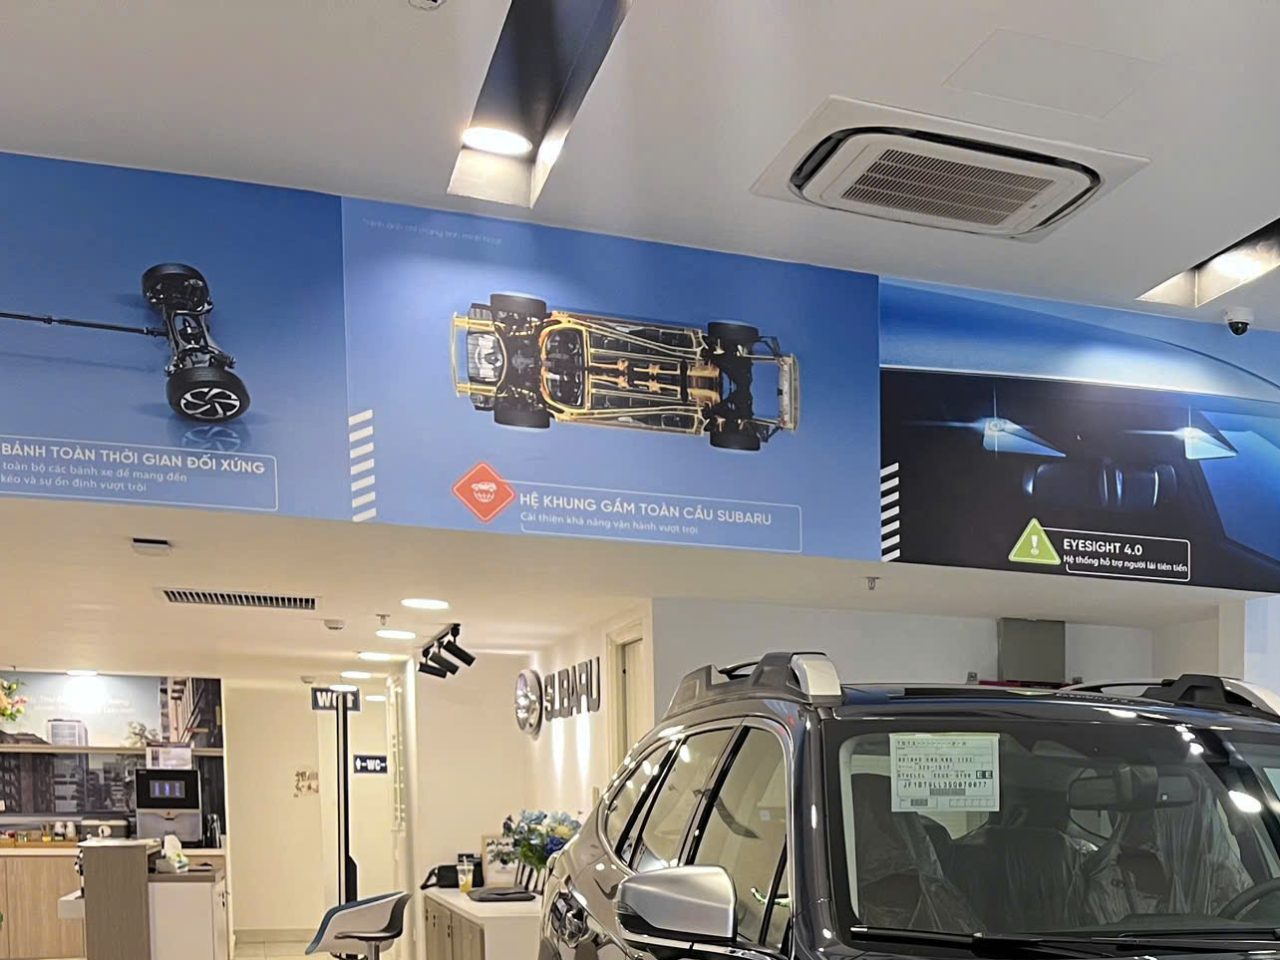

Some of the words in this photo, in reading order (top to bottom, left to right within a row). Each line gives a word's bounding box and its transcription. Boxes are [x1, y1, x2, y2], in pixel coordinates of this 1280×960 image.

[50, 445, 96, 461] TOÀN
[142, 453, 182, 467] GIAN
[187, 453, 216, 470] ĐỐI
[220, 457, 265, 474] XỨNG
[2, 461, 28, 471] toàn
[31, 461, 46, 473] bộ
[48, 464, 66, 475] các
[69, 464, 98, 476] bánh
[101, 468, 113, 477] xe
[132, 471, 164, 482] mang
[24, 474, 36, 485] và
[72, 478, 97, 490] định
[520, 491, 539, 509] HỆ
[543, 494, 597, 511] KHUNG
[639, 502, 679, 518] TOÀN
[717, 509, 772, 525] SUBARU
[1063, 538, 1121, 553] EYESIGHT
[1123, 543, 1143, 556] 4.0
[1063, 554, 1074, 564] Hệ
[1075, 555, 1099, 566] thống
[544, 656, 600, 722] SUBARU
